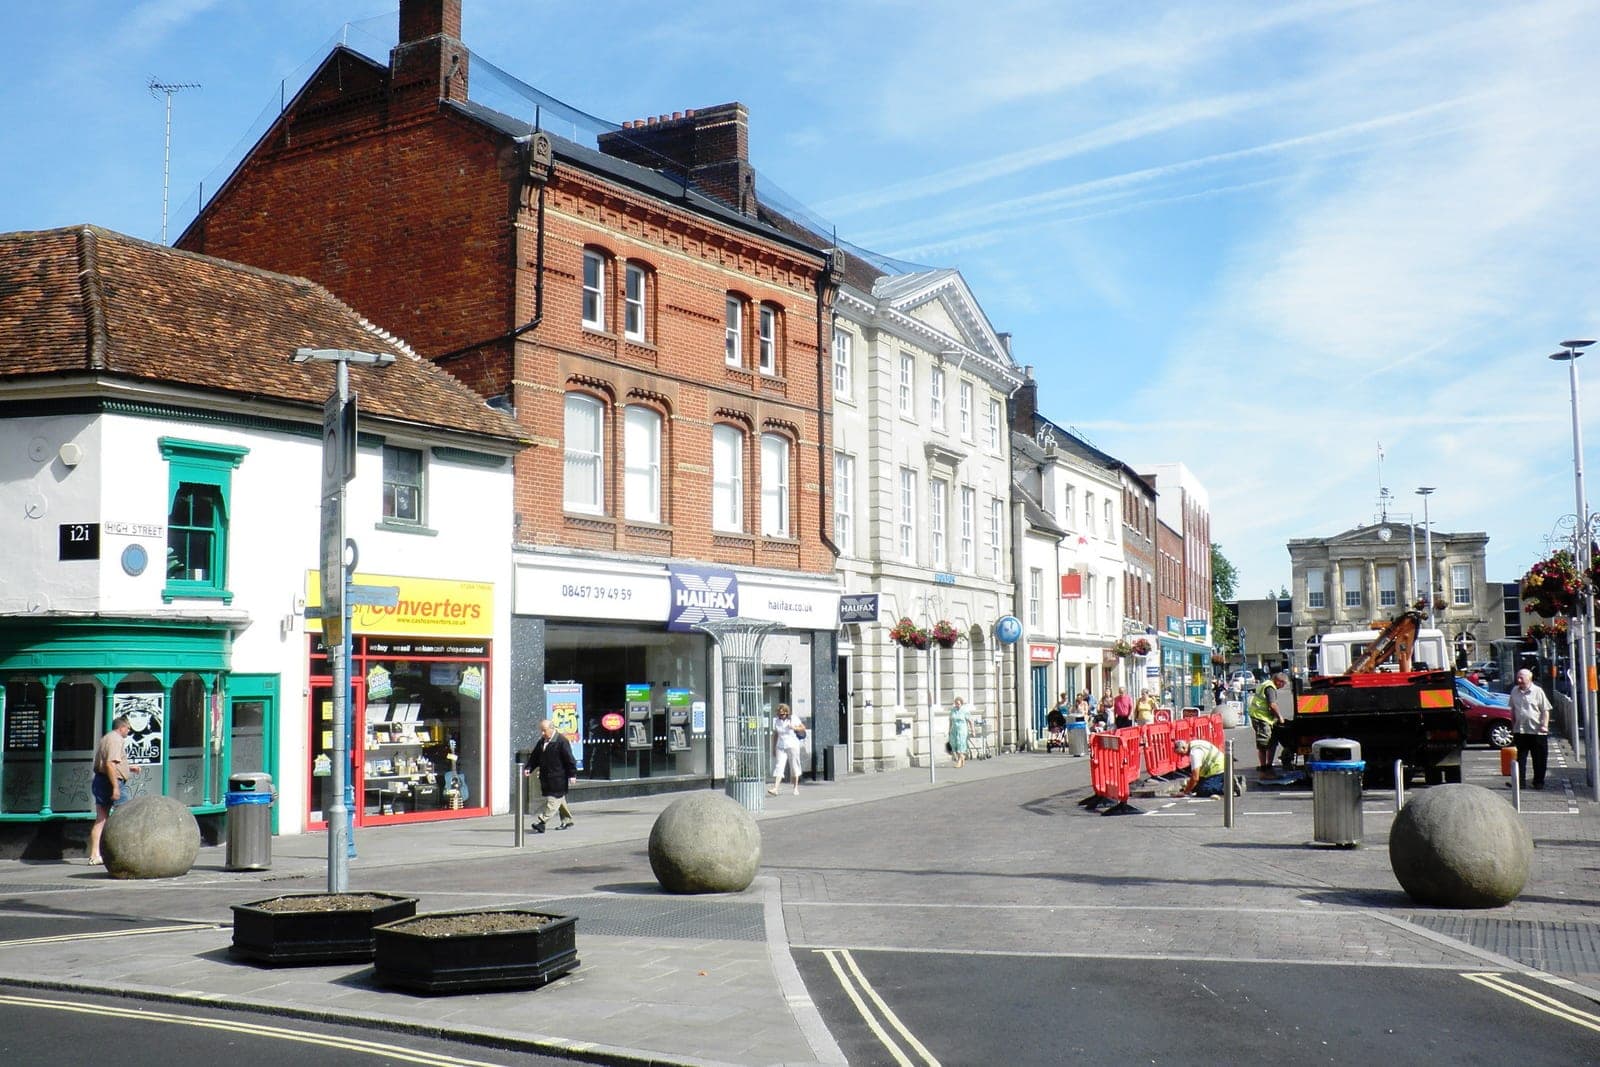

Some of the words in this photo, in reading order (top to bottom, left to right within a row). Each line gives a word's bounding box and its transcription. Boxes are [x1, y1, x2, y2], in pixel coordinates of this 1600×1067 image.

[70, 525, 90, 541] i2i
[106, 523, 128, 533] HIGH
[132, 525, 163, 536] STREET
[562, 584, 592, 598] 08457
[594, 586, 605, 599] 39
[608, 588, 619, 600] 49
[621, 589, 632, 601] 59
[676, 589, 735, 610] HALIFAX
[768, 600, 812, 613] halifax.co.uk
[841, 603, 874, 613] HALIFAX
